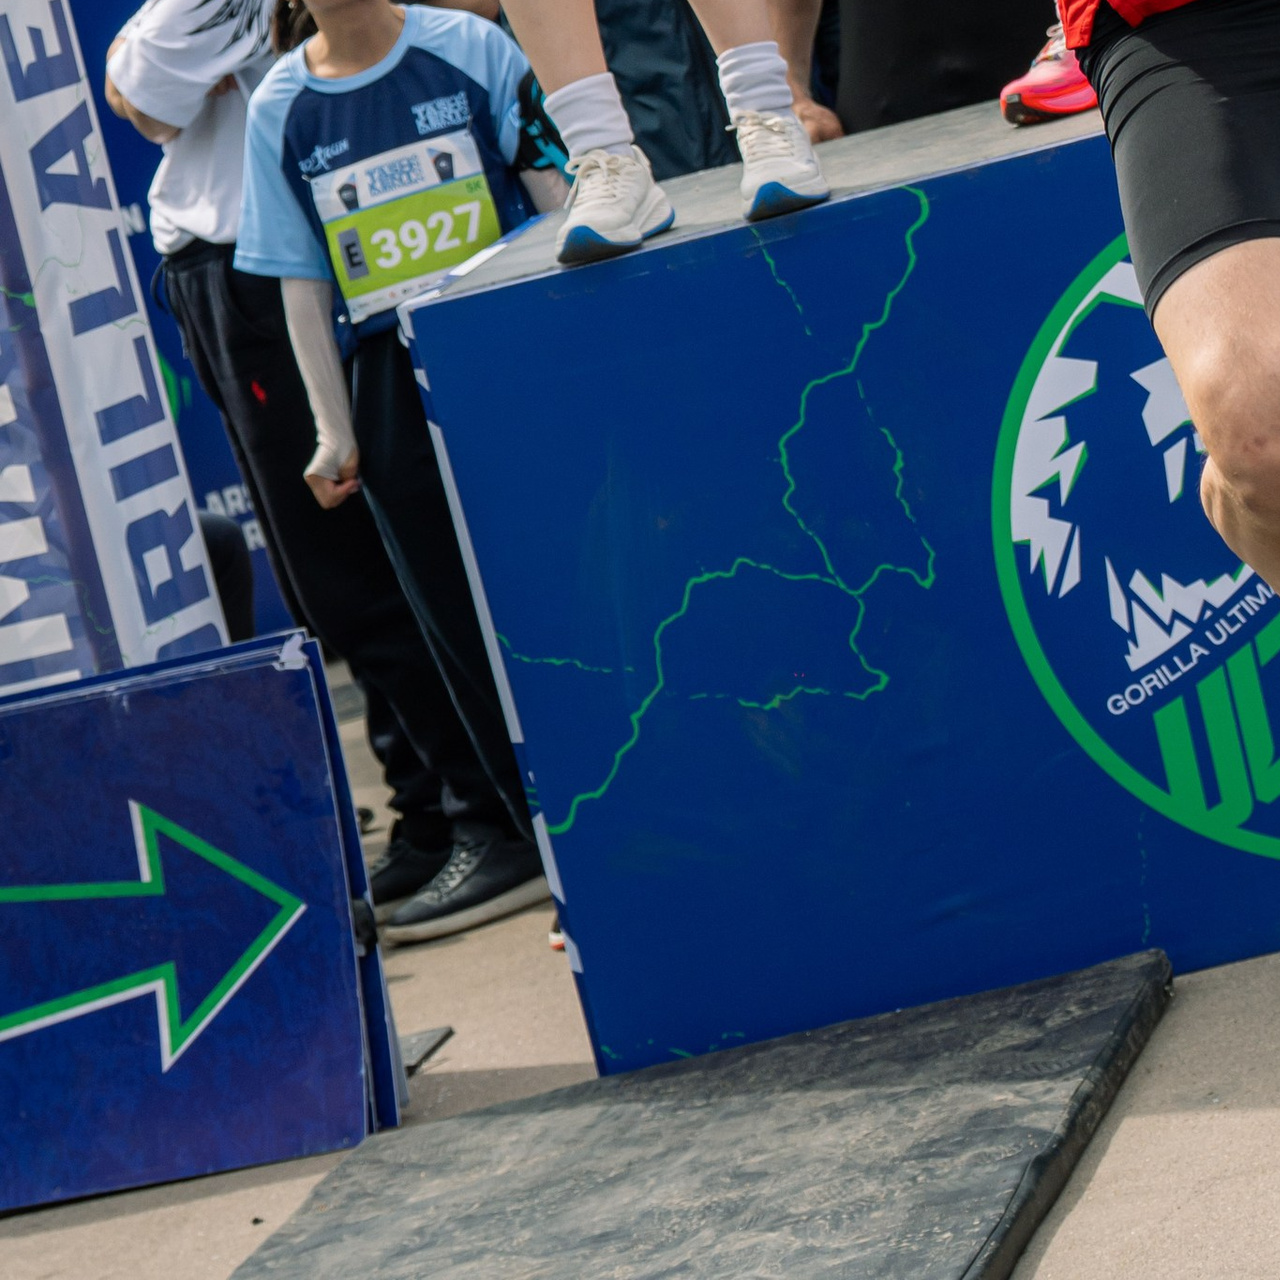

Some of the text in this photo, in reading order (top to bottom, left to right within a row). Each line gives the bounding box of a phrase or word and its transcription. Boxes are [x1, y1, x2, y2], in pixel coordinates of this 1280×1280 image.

[344, 200, 481, 270] E 3927
[1106, 639, 1211, 716] GORILLA
[1204, 582, 1276, 646] ULTIM
